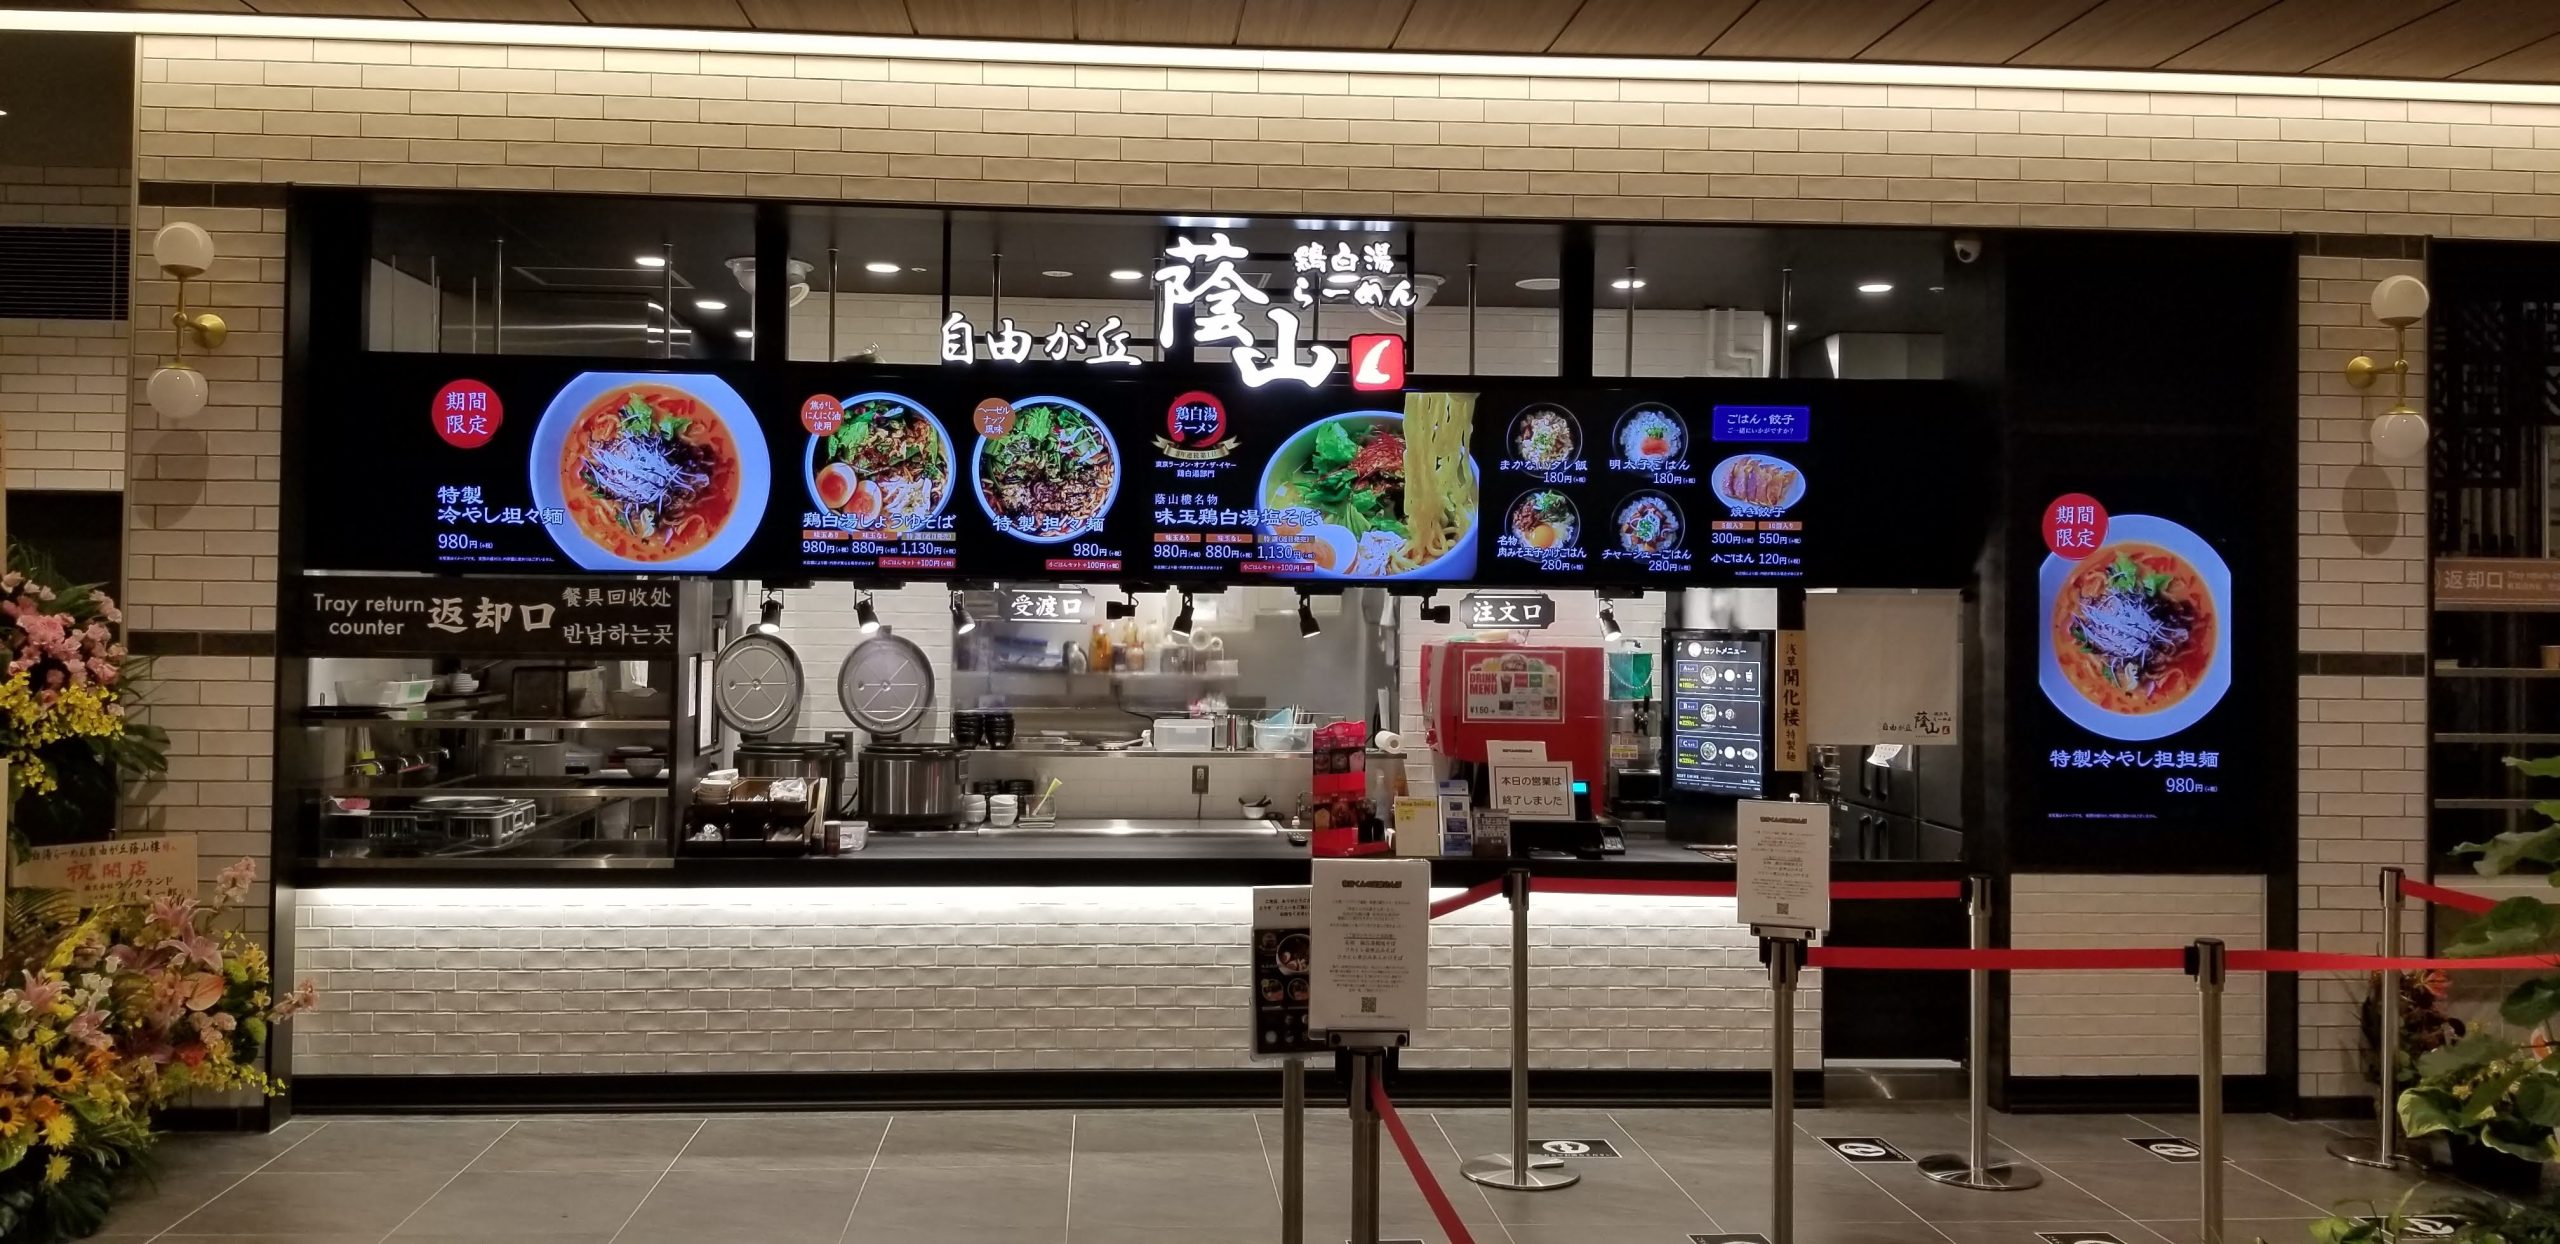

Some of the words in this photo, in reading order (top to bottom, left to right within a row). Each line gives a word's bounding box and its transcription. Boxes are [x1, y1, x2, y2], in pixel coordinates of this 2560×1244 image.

[1294, 241, 1395, 274] 鶏白湯
[1292, 276, 1418, 309] らーめん
[1155, 232, 1338, 388] 蔭山
[940, 311, 1143, 366] 自由が丘
[446, 391, 487, 412] 期間
[810, 400, 834, 410] 焦がし
[805, 411, 841, 420] にんにく油
[984, 416, 1005, 424] ナッツ
[1175, 406, 1217, 421] 鶏白湯
[446, 415, 489, 436] 限定
[814, 421, 832, 431] 使用
[985, 425, 1004, 434] 風味
[1174, 421, 1219, 434] ラーメン
[1500, 460, 1588, 471] まかないタレ飯
[1609, 460, 1691, 472] 明太子ごはん
[437, 485, 484, 504] 特製
[803, 512, 957, 529] 鶏白湯しょうゆそば
[1154, 507, 1322, 526] 味玉鶏白湯塩そば
[1730, 506, 1786, 518] 焼き餃子
[2056, 505, 2095, 525] 期間
[992, 514, 1105, 532] 特製担々麺
[1497, 536, 1518, 546] 名物
[2056, 528, 2096, 548] 限定
[1601, 549, 1692, 560] チャーシューごはん
[1711, 553, 1755, 563] 小ごはん
[2444, 570, 2503, 590] 返却口
[313, 593, 358, 618] Tray
[365, 595, 425, 613] return
[562, 586, 672, 608] 餐具回收处
[1010, 594, 1082, 618] 受渡口
[1472, 601, 1542, 623] 注文口
[427, 596, 556, 635] 返却口
[329, 620, 405, 636] counter
[563, 623, 673, 646] 반납하는곳
[1703, 646, 1747, 655] セットメニュー
[1469, 673, 1497, 684] DRINK
[1469, 684, 1498, 696] MENU
[2049, 749, 2220, 768] 特製冷やし担担麺
[1501, 776, 1562, 787] 本日の営業は
[1502, 795, 1563, 806] 終了しました
